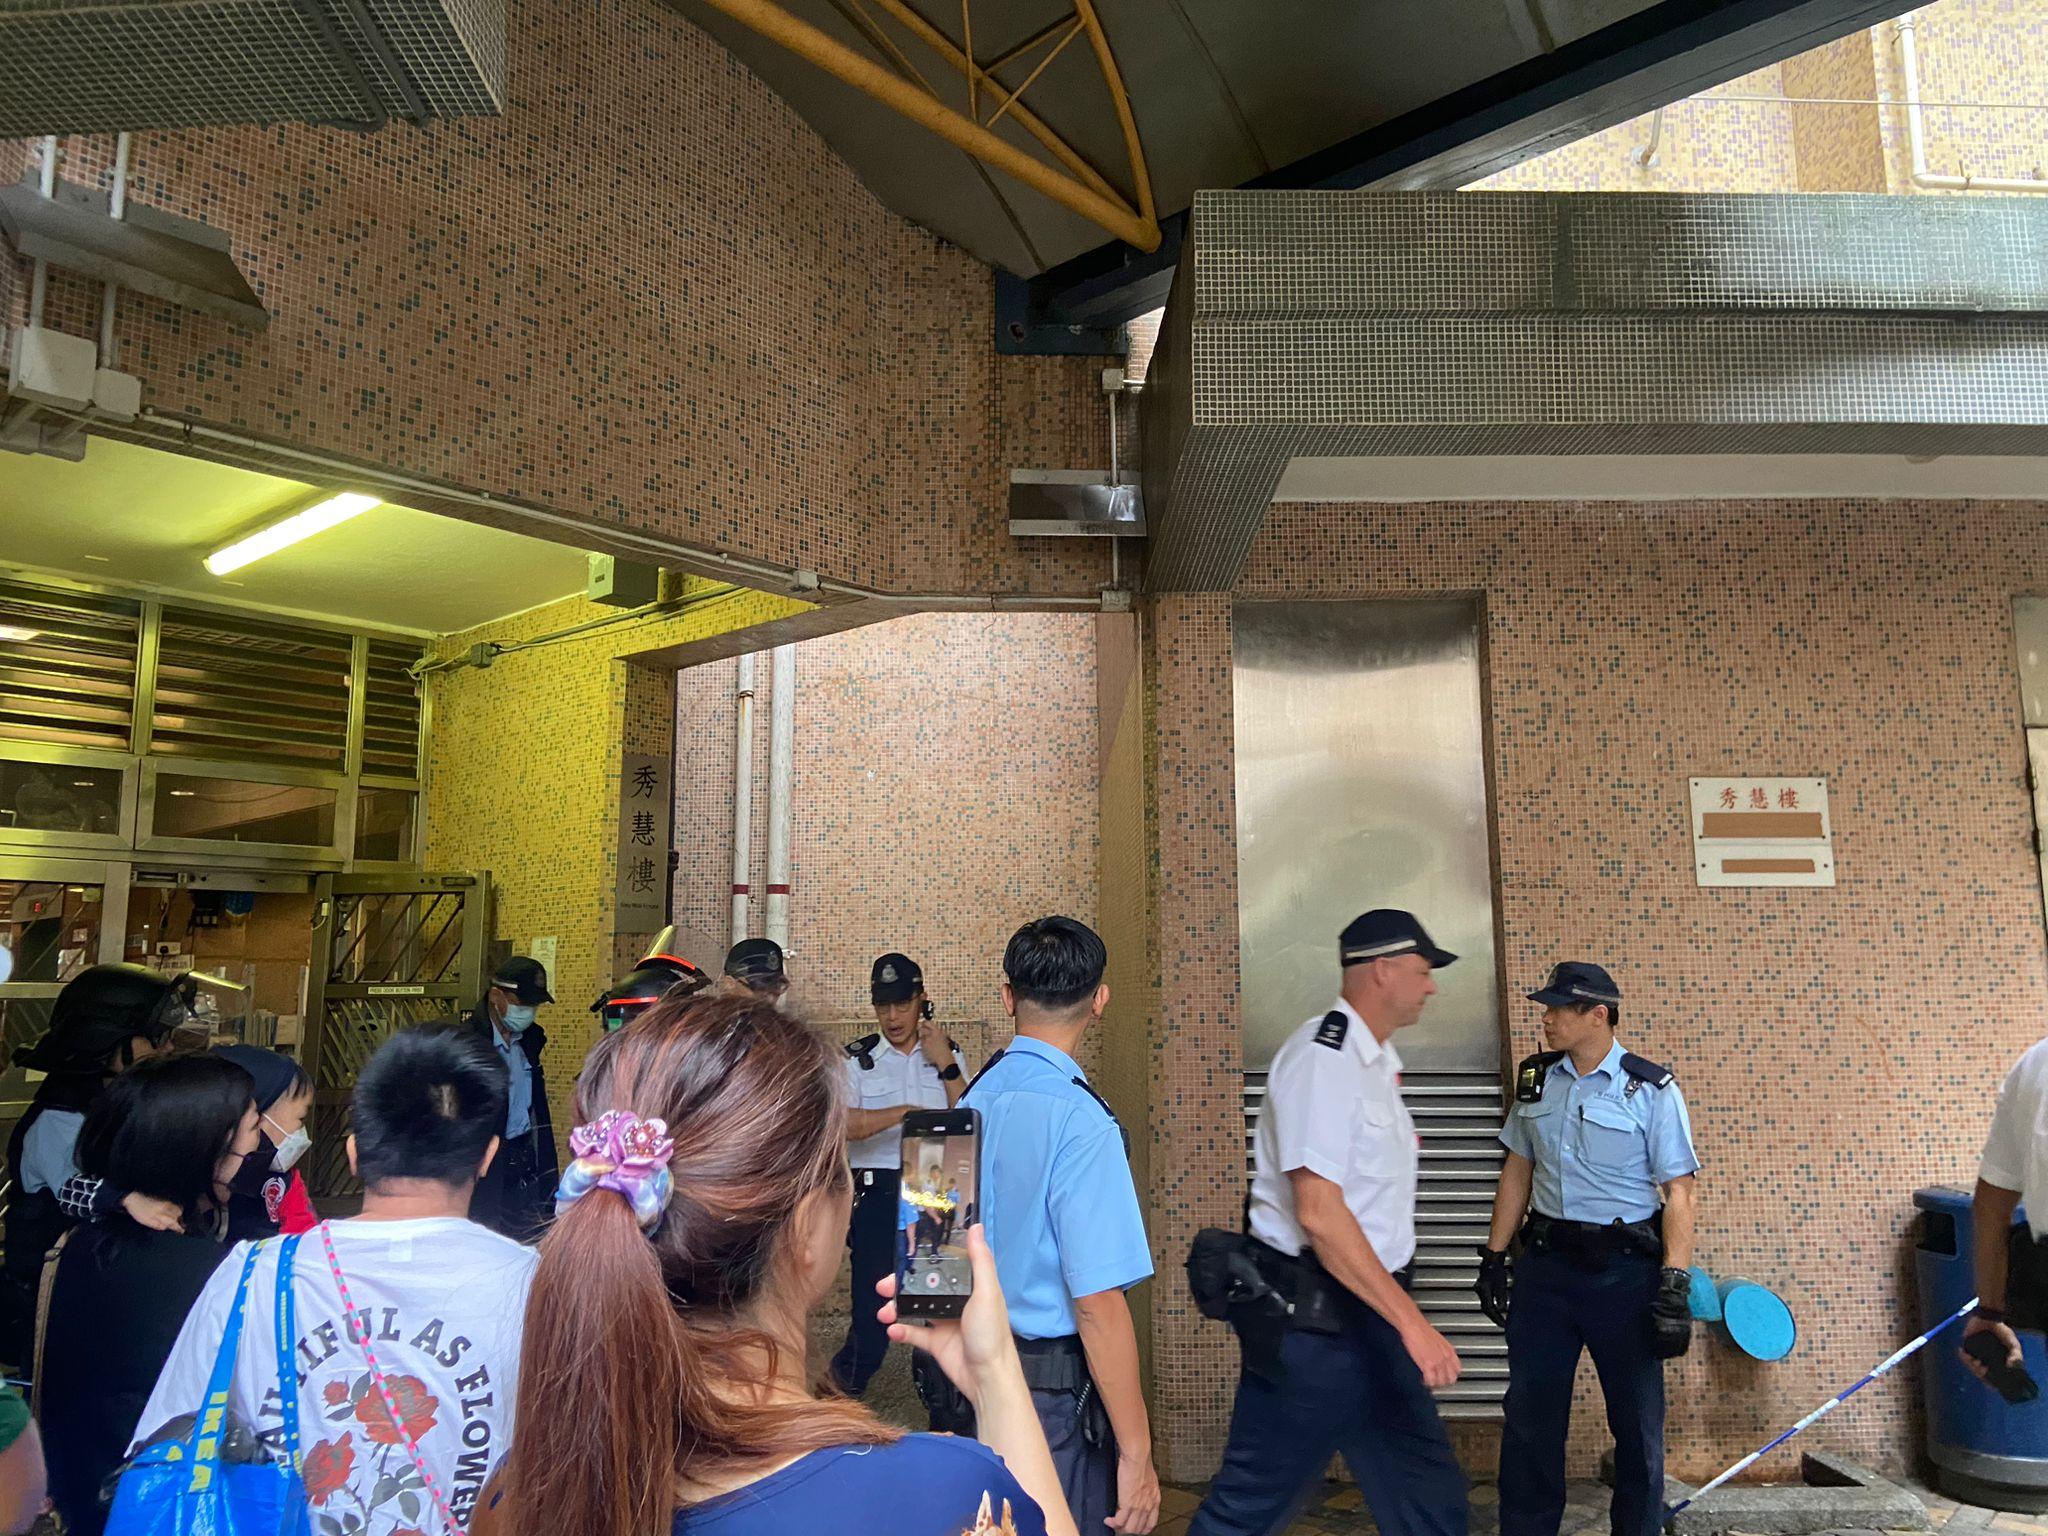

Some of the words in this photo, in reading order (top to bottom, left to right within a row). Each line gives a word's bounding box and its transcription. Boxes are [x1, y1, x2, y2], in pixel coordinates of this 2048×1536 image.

[627, 765, 658, 893] 秀慧樓
[1720, 787, 1800, 810] 秀慧樓
[409, 1318, 473, 1369] AS
[188, 1390, 230, 1494] IKEA
